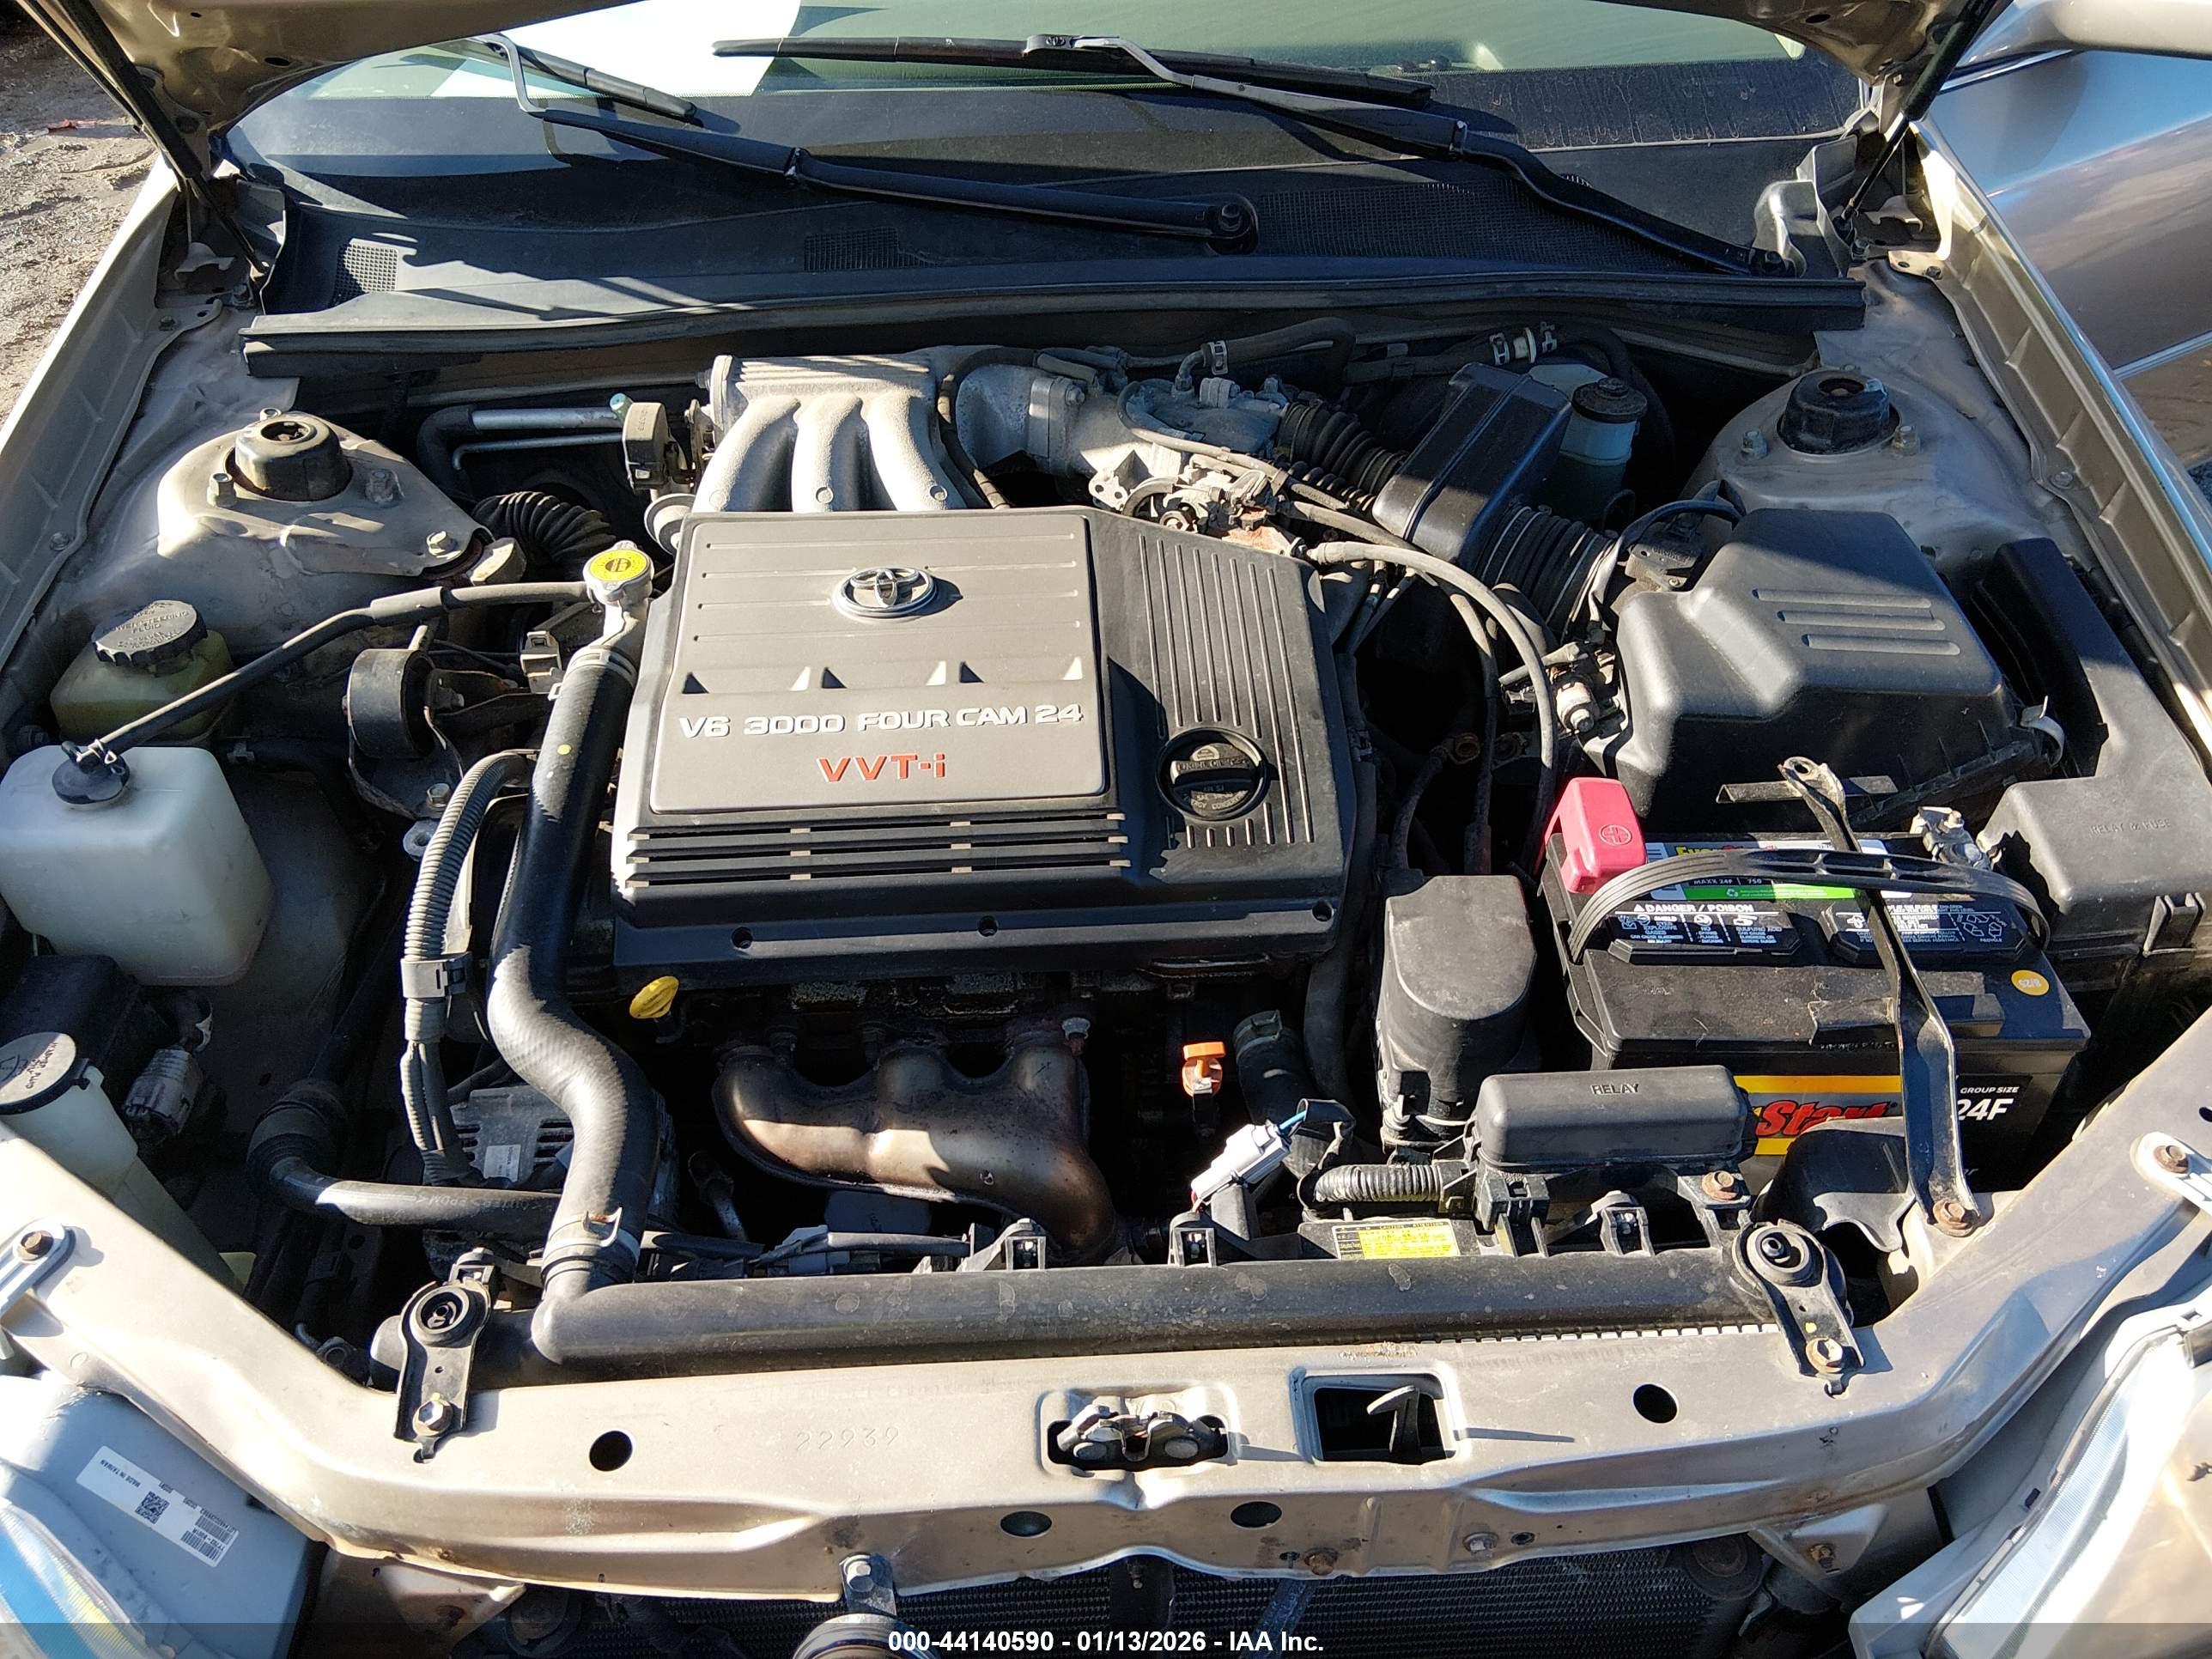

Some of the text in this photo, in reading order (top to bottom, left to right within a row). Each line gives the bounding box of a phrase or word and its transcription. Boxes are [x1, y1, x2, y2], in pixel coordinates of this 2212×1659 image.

[131, 623, 162, 634] FLUID
[678, 703, 1085, 738] V6 3000 FOUR CAM 24
[817, 752, 946, 783] VVT-i
[2088, 823, 2124, 836] RELAY
[2142, 817, 2172, 830] FUSE
[1645, 903, 1696, 913] DANGER
[1707, 904, 1754, 913] POISON
[1590, 1083, 1639, 1095] RELAY
[1957, 1098, 2014, 1121] 24F
